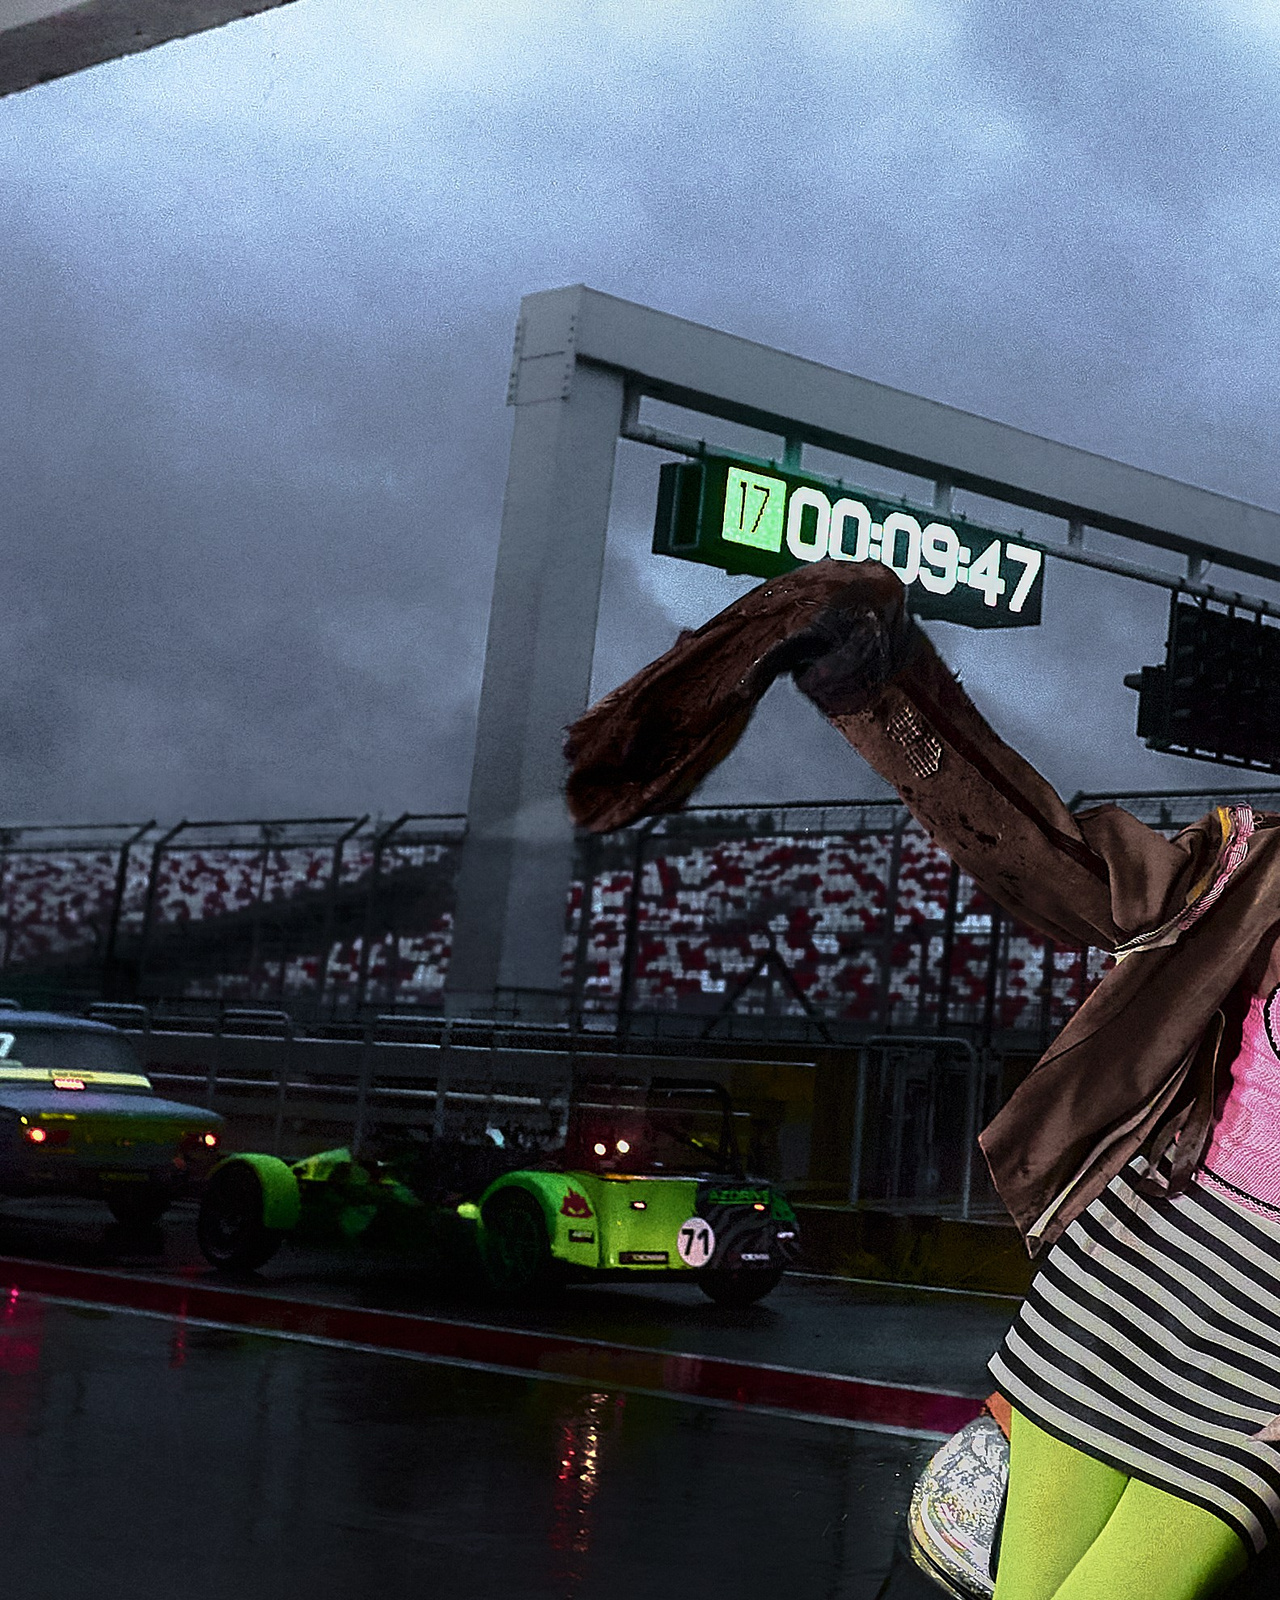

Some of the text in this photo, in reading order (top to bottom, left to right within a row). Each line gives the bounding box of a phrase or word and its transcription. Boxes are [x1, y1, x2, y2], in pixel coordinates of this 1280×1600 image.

[739, 480, 770, 534] 17
[786, 486, 1042, 612] 00:09:47
[682, 1229, 709, 1256] 71
